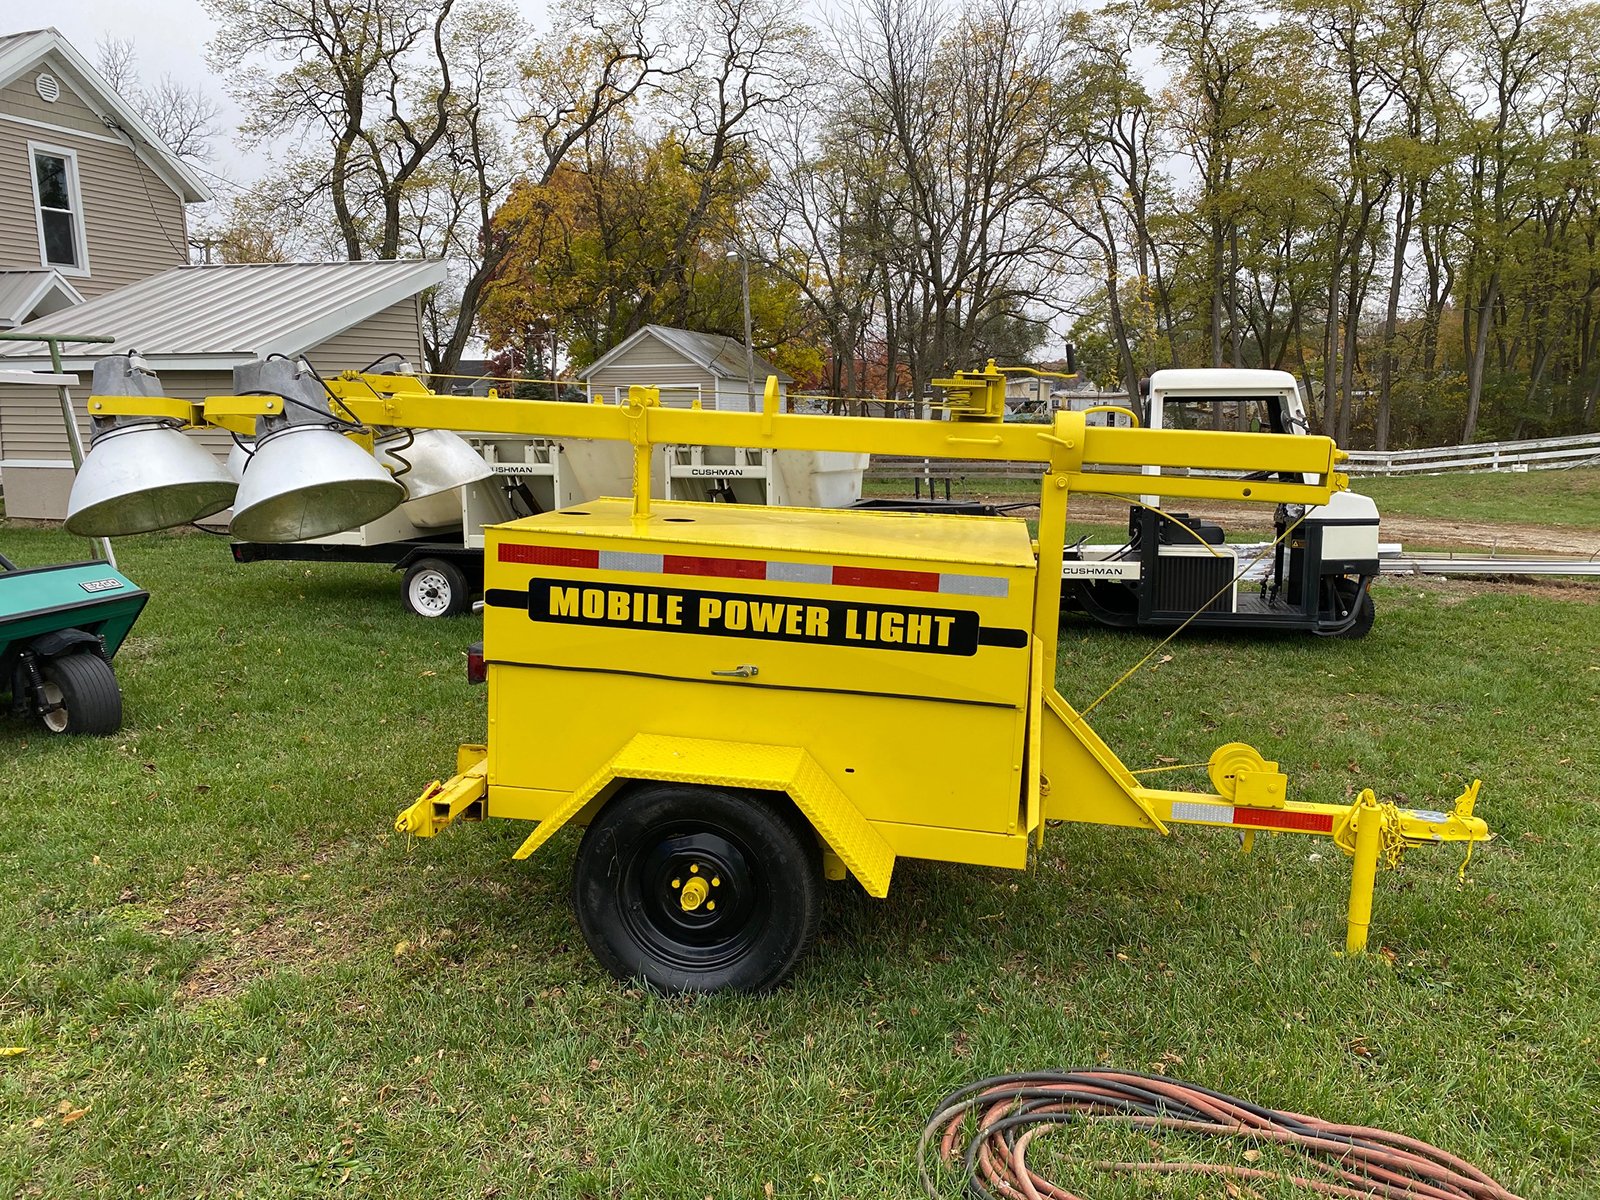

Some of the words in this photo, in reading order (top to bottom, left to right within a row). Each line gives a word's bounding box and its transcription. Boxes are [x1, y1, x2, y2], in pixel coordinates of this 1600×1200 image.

[1062, 567, 1123, 575] CUSHMAN
[549, 586, 683, 625] MOBILE
[699, 597, 830, 637] POWER
[845, 609, 955, 647] LIGHT
